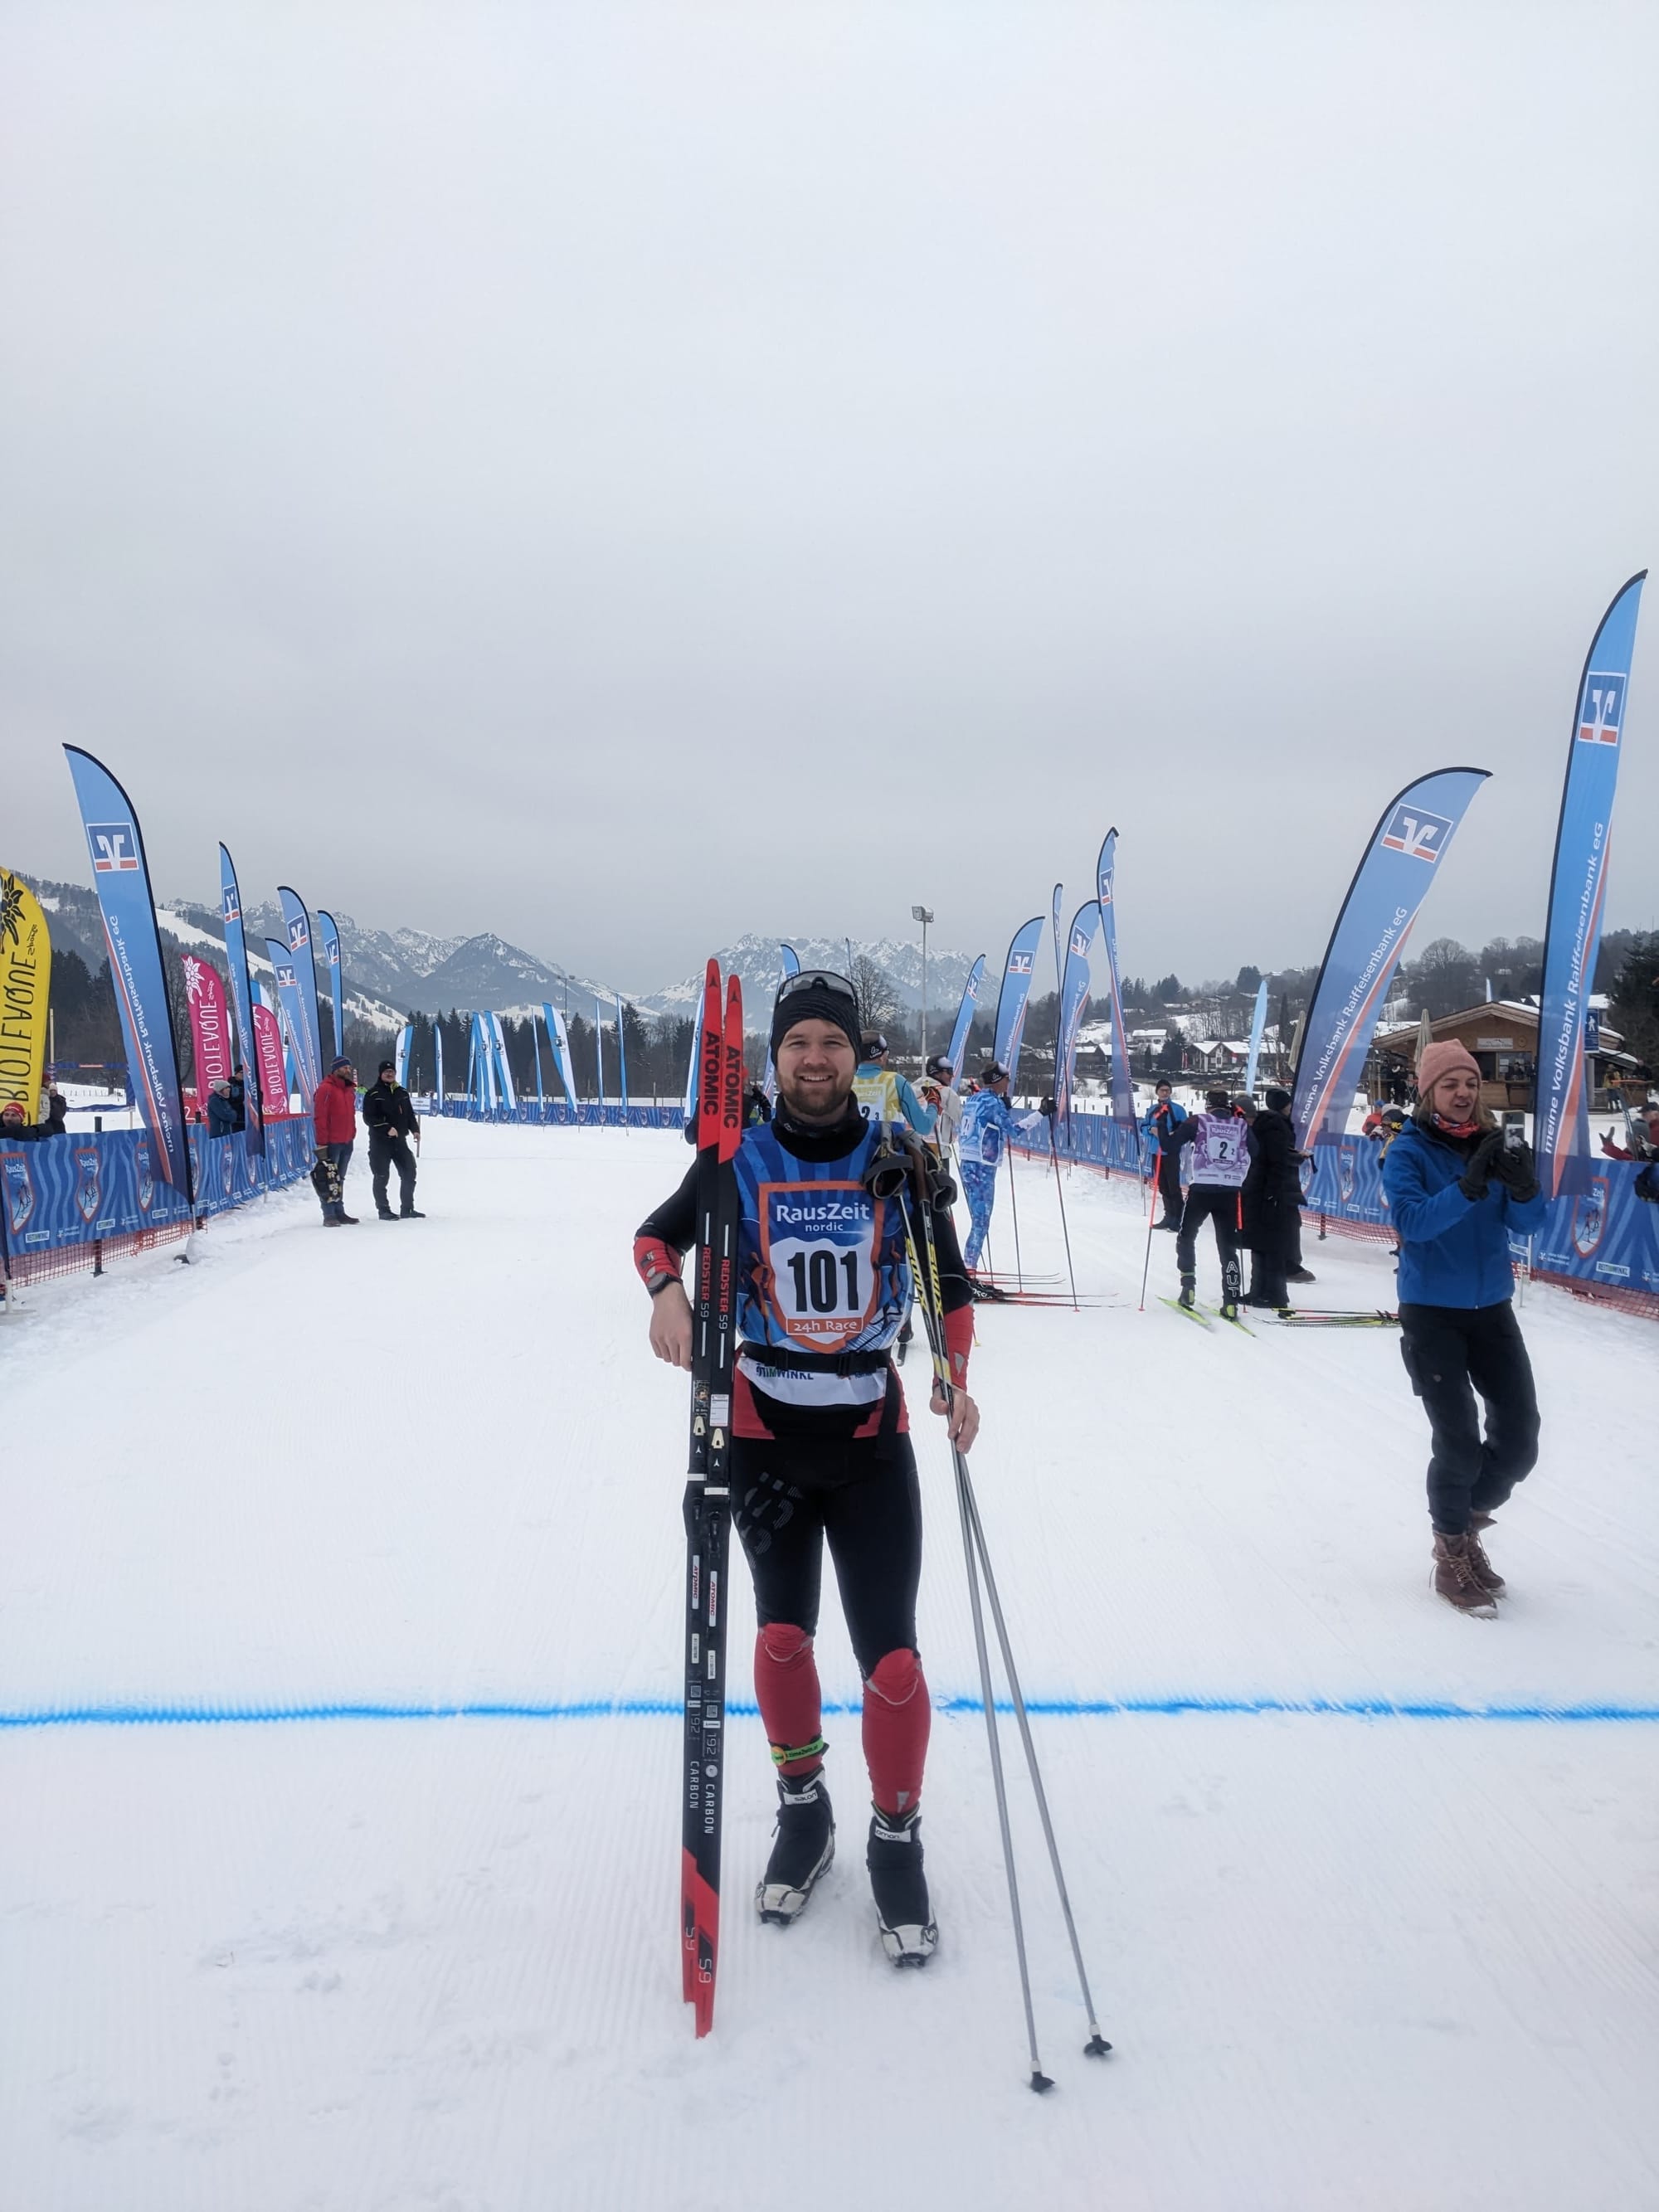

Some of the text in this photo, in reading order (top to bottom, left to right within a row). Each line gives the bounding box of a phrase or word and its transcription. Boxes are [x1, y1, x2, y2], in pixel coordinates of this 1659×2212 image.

[1545, 822, 1604, 1155] meine Volksbank Raiffeisenbank eG
[1300, 907, 1408, 1124] meine Volksbank Raiffeisenbank eG
[704, 1031, 720, 1116] ATOMIC
[724, 1046, 741, 1129] ATOMIC
[875, 1111, 879, 1121] 3
[1219, 1141, 1228, 1159] 2
[776, 1203, 869, 1224] RausZeit
[805, 1222, 844, 1232] nordic
[700, 1247, 712, 1319] REDSTER S9
[719, 1259, 731, 1330] REDSTER S9
[787, 1250, 859, 1313] 101
[1226, 1261, 1239, 1298] AUT
[794, 1320, 858, 1333] 24h Race
[690, 1714, 701, 1733] 192
[707, 1733, 717, 1755] 192
[689, 1761, 700, 1809] CARBON
[704, 1784, 715, 1834] CARBON
[698, 1958, 712, 1983] S9
